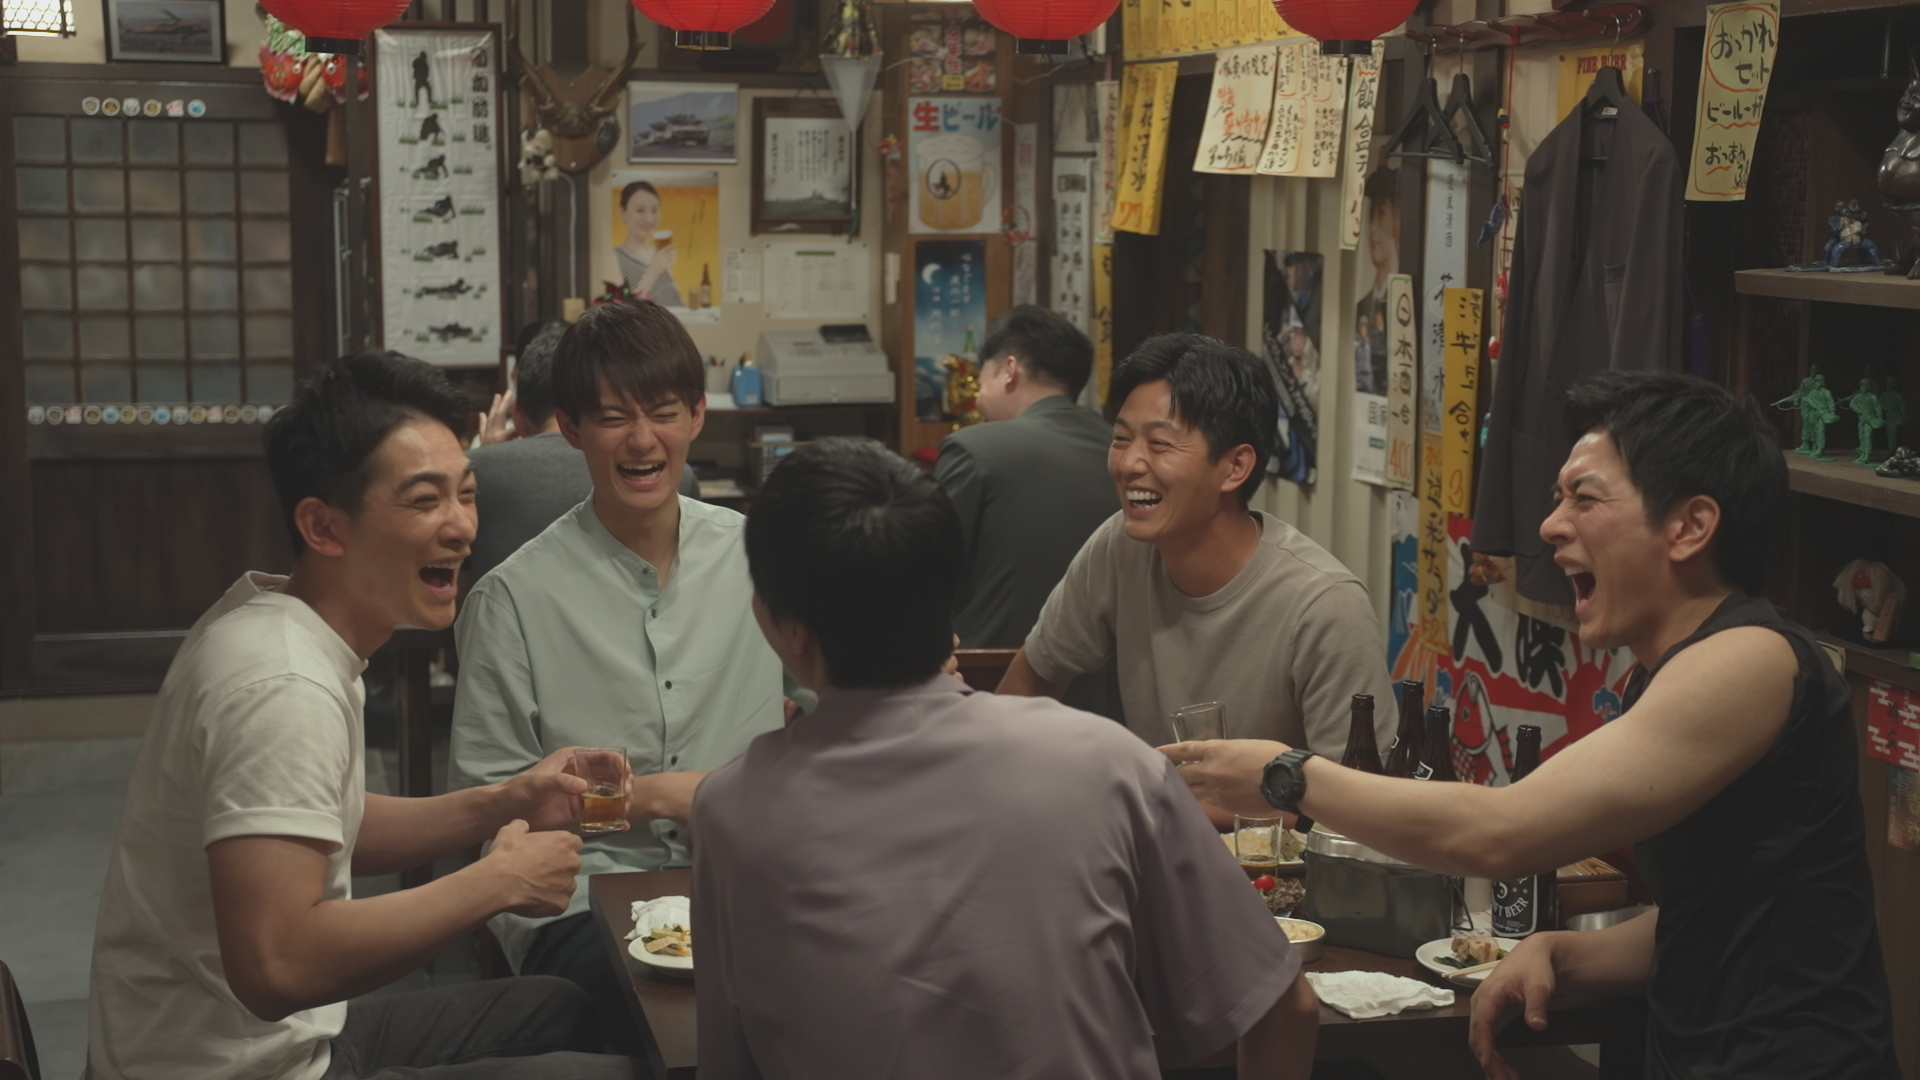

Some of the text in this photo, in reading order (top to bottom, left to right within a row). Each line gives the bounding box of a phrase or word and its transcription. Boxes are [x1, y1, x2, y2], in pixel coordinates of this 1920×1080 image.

[1735, 57, 1770, 84] セット
[912, 101, 998, 131] 生ビール
[1504, 896, 1529, 918] BEER
